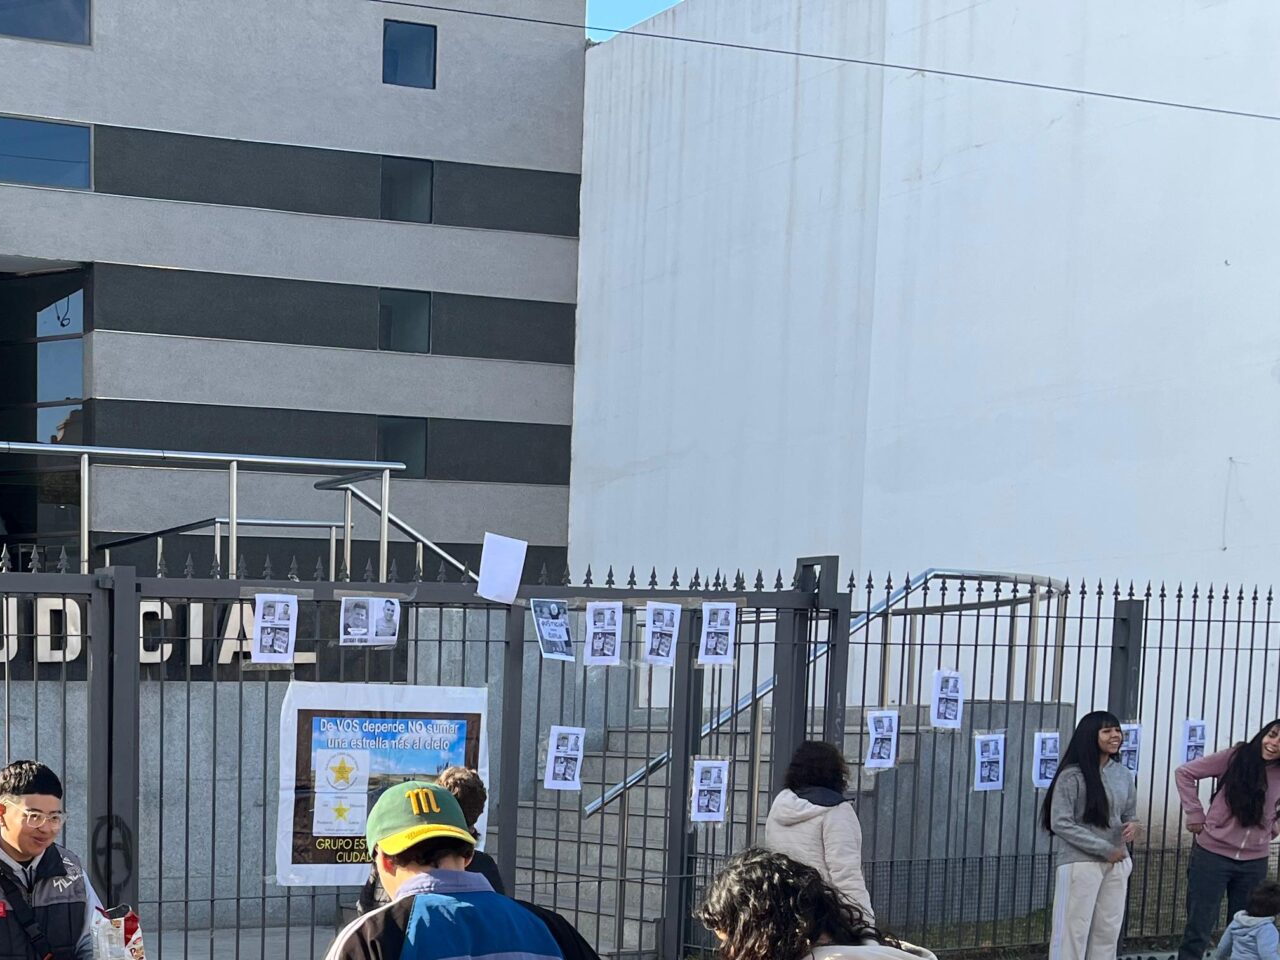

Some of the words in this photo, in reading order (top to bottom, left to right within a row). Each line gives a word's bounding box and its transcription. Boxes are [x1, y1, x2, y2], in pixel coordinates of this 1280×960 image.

[320, 718, 334, 731] De
[336, 719, 360, 732] VOS
[362, 720, 405, 735] depende
[408, 720, 425, 733] NO
[426, 722, 459, 734] sumar
[327, 738, 348, 749] una
[350, 736, 389, 749] estrella
[412, 737, 422, 750] al
[424, 737, 450, 750] cielo
[315, 838, 353, 850] GRUPO
